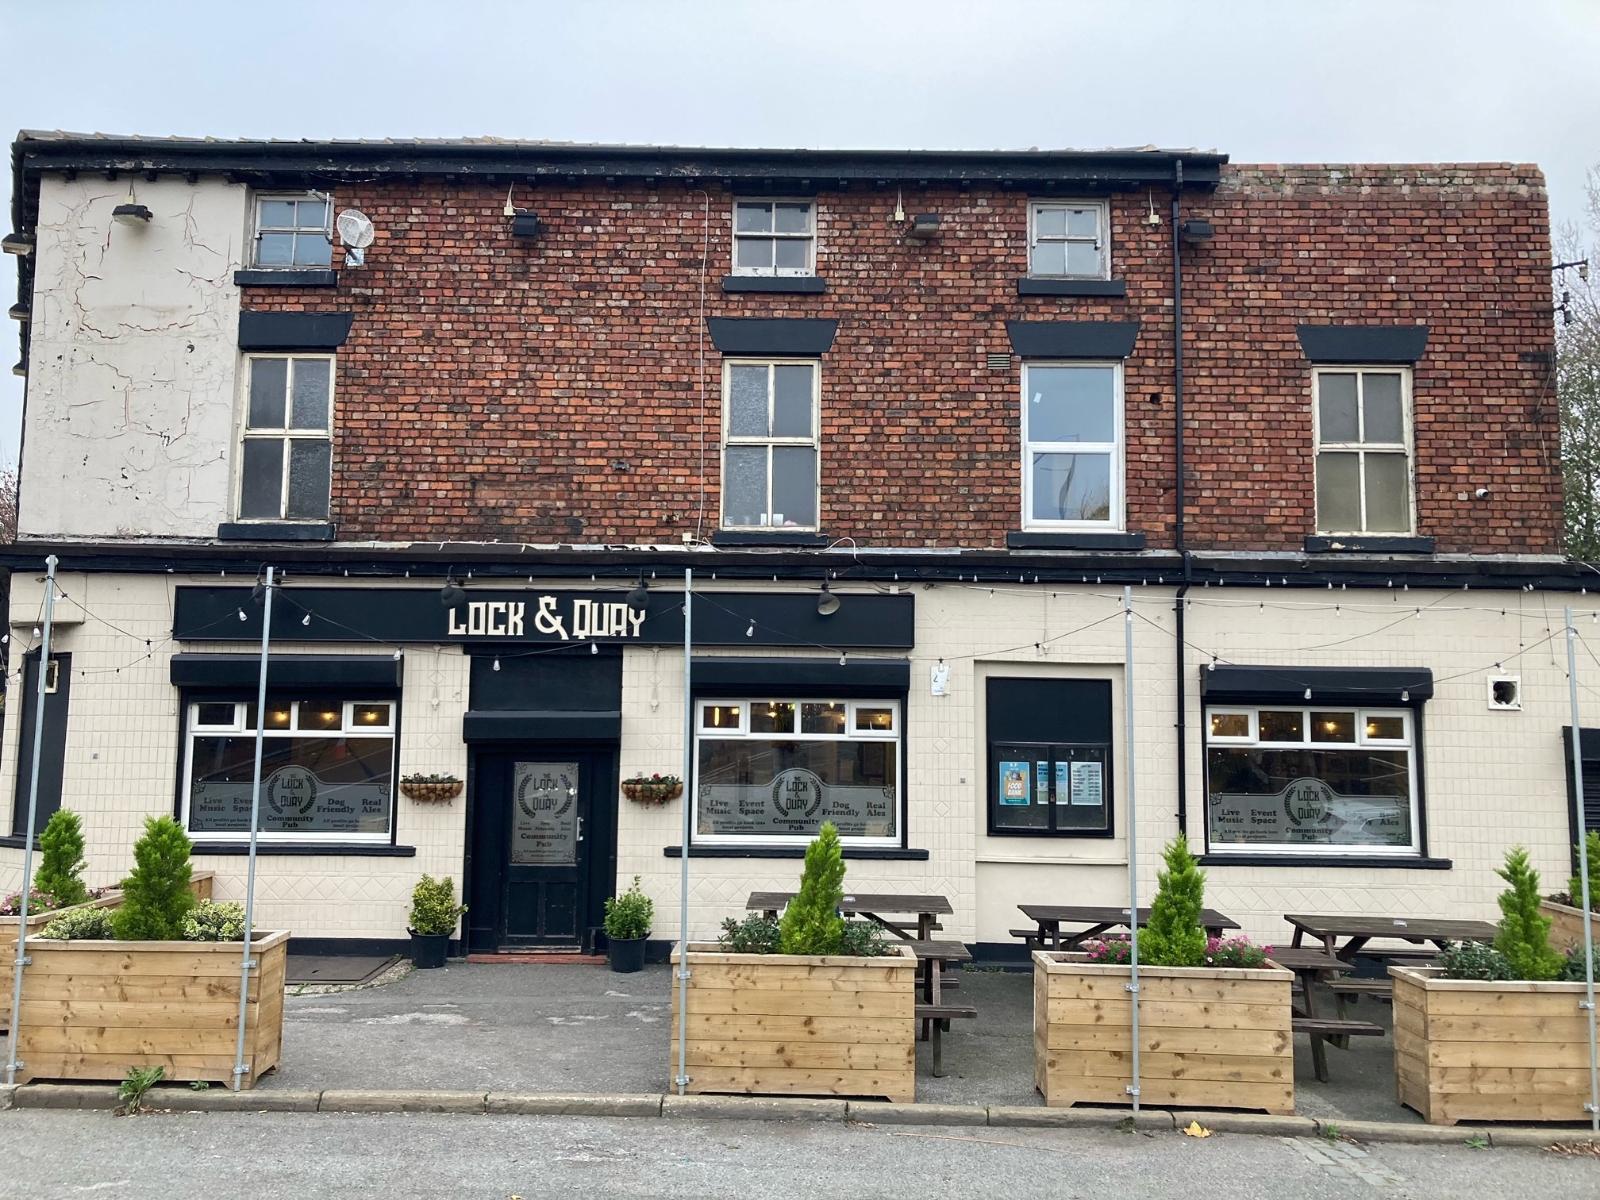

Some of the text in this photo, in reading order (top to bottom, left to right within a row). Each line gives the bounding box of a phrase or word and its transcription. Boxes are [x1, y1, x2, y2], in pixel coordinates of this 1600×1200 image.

[448, 596, 646, 640] LOCK & QUAY
[282, 778, 304, 789] LOCK
[534, 778, 558, 790] LOCK
[786, 781, 808, 792] LOCK
[1298, 790, 1320, 801] LOCK
[532, 798, 558, 811] QUAY
[786, 798, 808, 810] QUAY
[317, 806, 355, 814] Friendly
[822, 809, 860, 817] Friendly
[1298, 808, 1320, 819] QUAY
